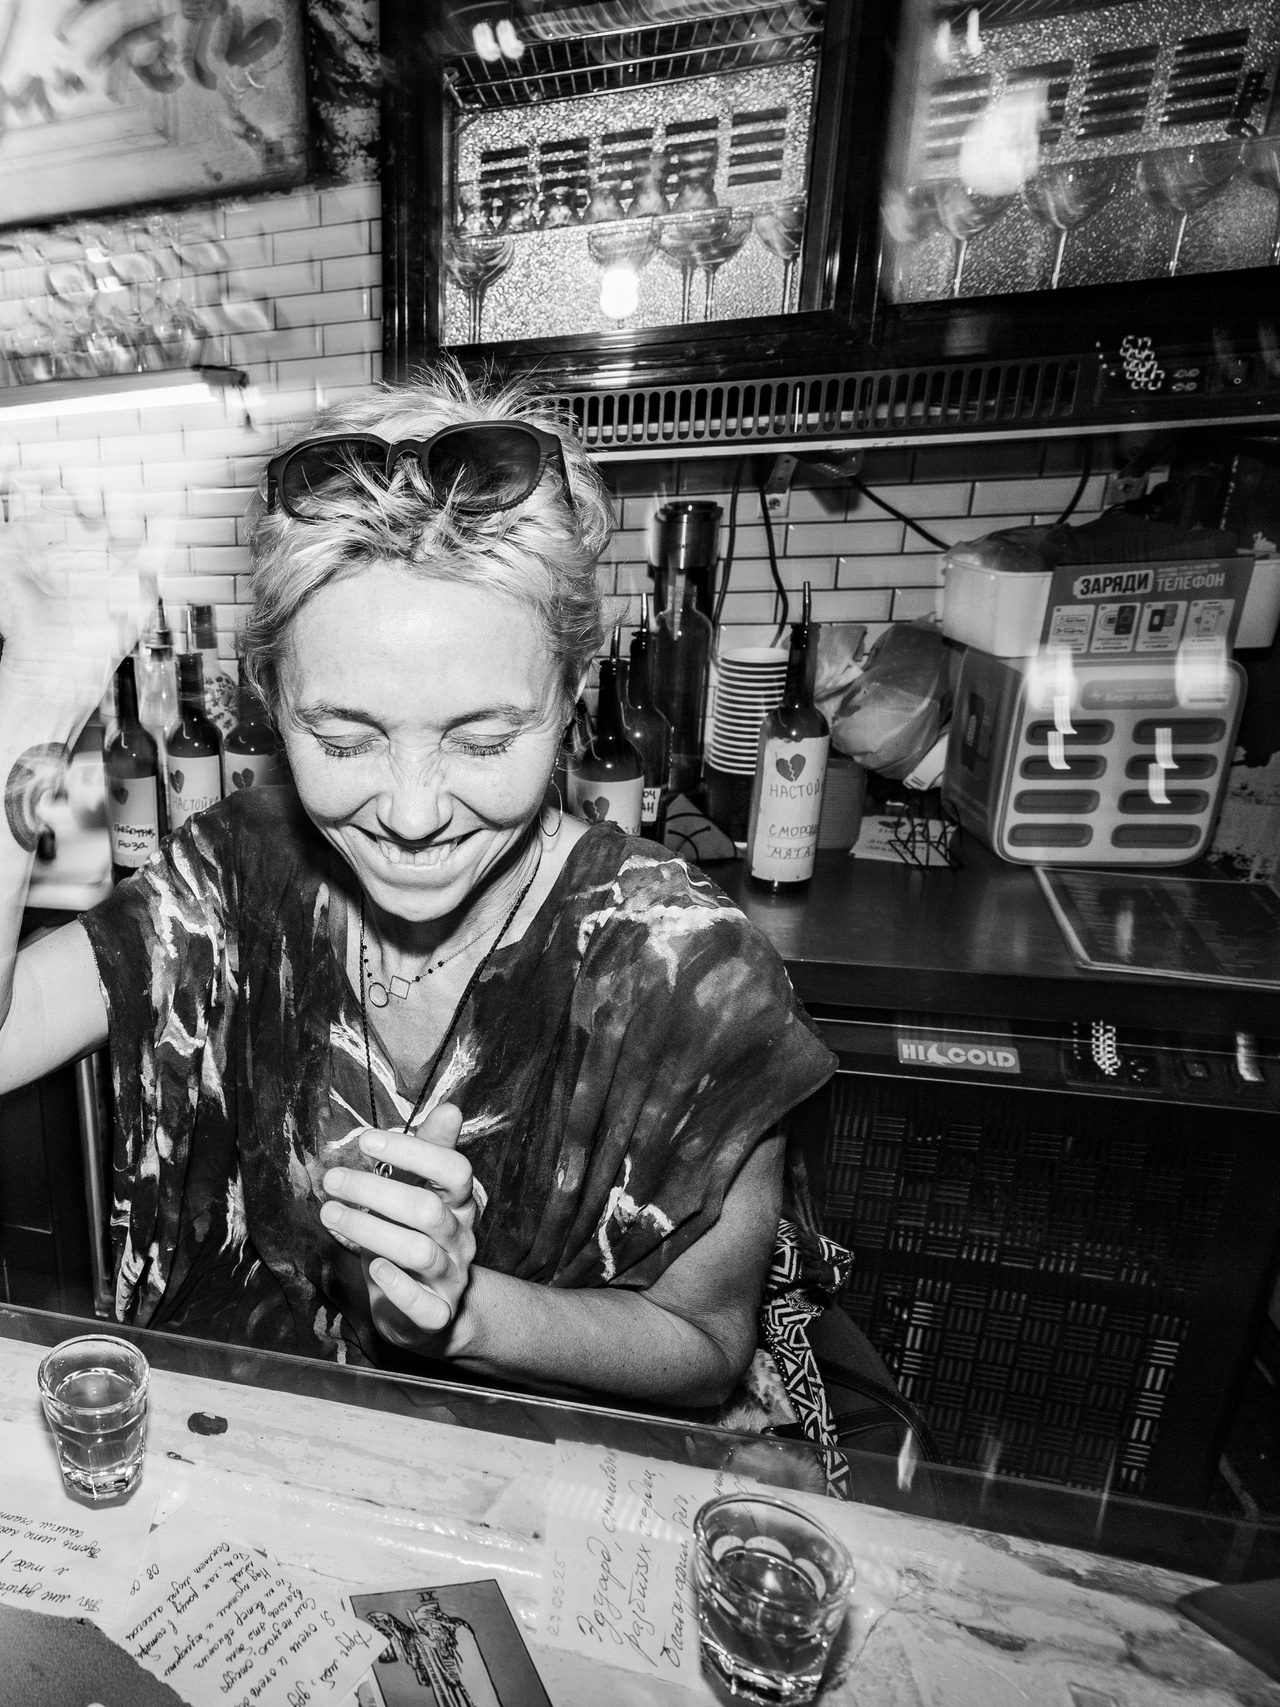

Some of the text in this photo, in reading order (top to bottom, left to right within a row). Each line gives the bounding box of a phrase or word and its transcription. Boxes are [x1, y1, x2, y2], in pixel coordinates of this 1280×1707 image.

[1079, 573, 1226, 596] ЗАРЯДИ ТЕЛЕФОН
[24, 1531, 56, 1543] лето
[63, 1535, 101, 1559] Пусть
[11, 1559, 45, 1573] тебе
[41, 1591, 71, 1603] мне
[576, 1536, 626, 1645] Эдуард,
[234, 1601, 266, 1626] ветер
[294, 1598, 316, 1618] Сам
[628, 1541, 660, 1668] разбитых
[167, 1620, 178, 1635] в
[320, 1611, 335, 1627] Я
[193, 1628, 234, 1669] свистит
[289, 1623, 317, 1653] очень
[335, 1630, 369, 1657] Друг
[277, 1656, 288, 1666] и
[250, 1668, 276, 1698] очень
